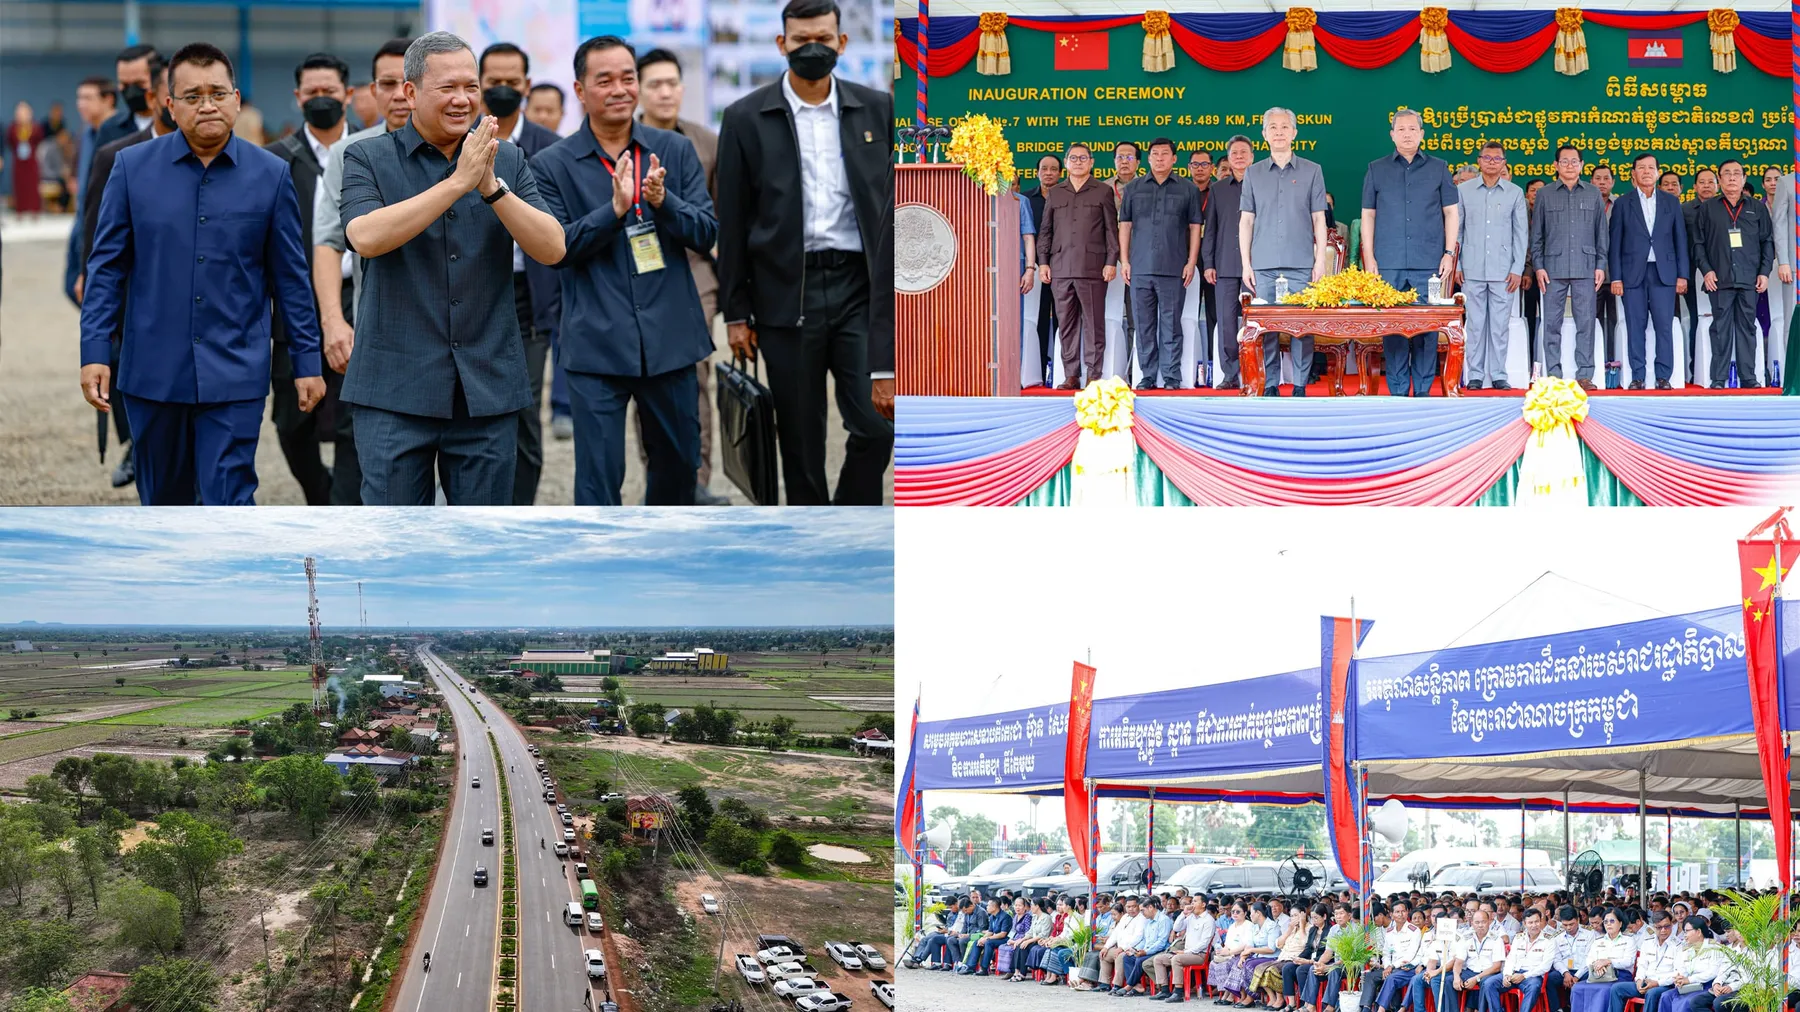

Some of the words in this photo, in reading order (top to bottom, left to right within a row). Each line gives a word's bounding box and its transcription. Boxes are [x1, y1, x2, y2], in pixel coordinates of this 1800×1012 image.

[968, 87, 1087, 101] INAUGURATION
[1094, 86, 1186, 100] CEREMONY
[1606, 75, 1707, 104] ពិធីសម្ពោធ
[925, 117, 943, 127] SE
[1026, 116, 1059, 127] WITH
[1066, 115, 1091, 126] THE
[1098, 115, 1149, 126] LENGTH
[1155, 115, 1172, 126] OF
[1177, 114, 1220, 126] 45.489
[1297, 114, 1332, 125] SKUN
[1017, 142, 1064, 152] BRIDGE
